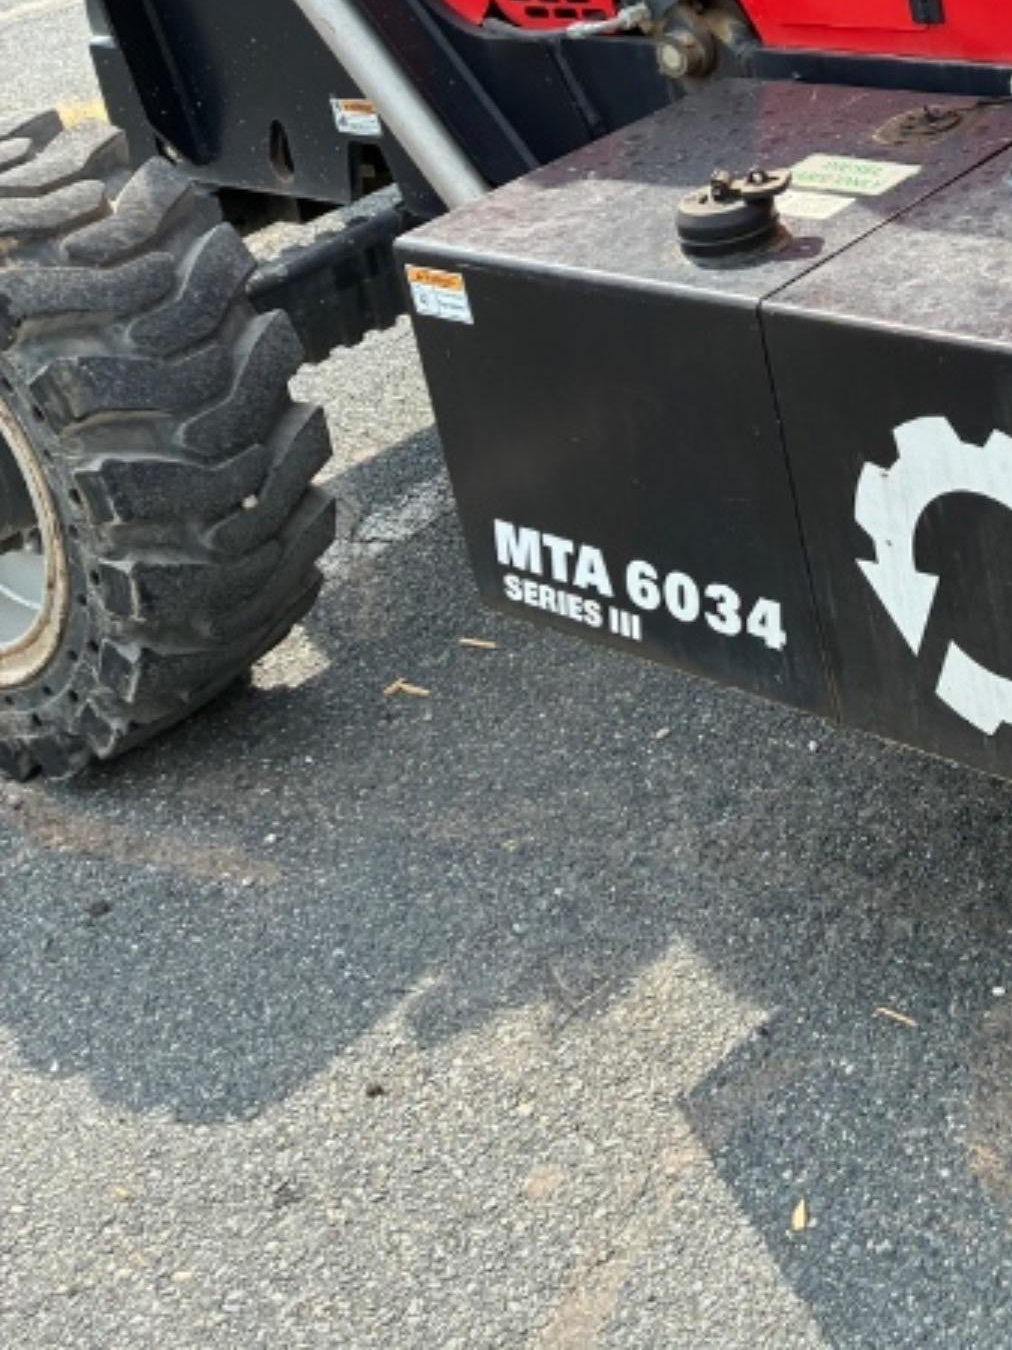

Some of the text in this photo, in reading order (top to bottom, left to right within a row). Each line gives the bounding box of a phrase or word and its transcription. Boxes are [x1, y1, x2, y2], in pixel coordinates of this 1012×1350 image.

[494, 518, 788, 651] MTA 6034
[502, 574, 643, 643] SERIES III
